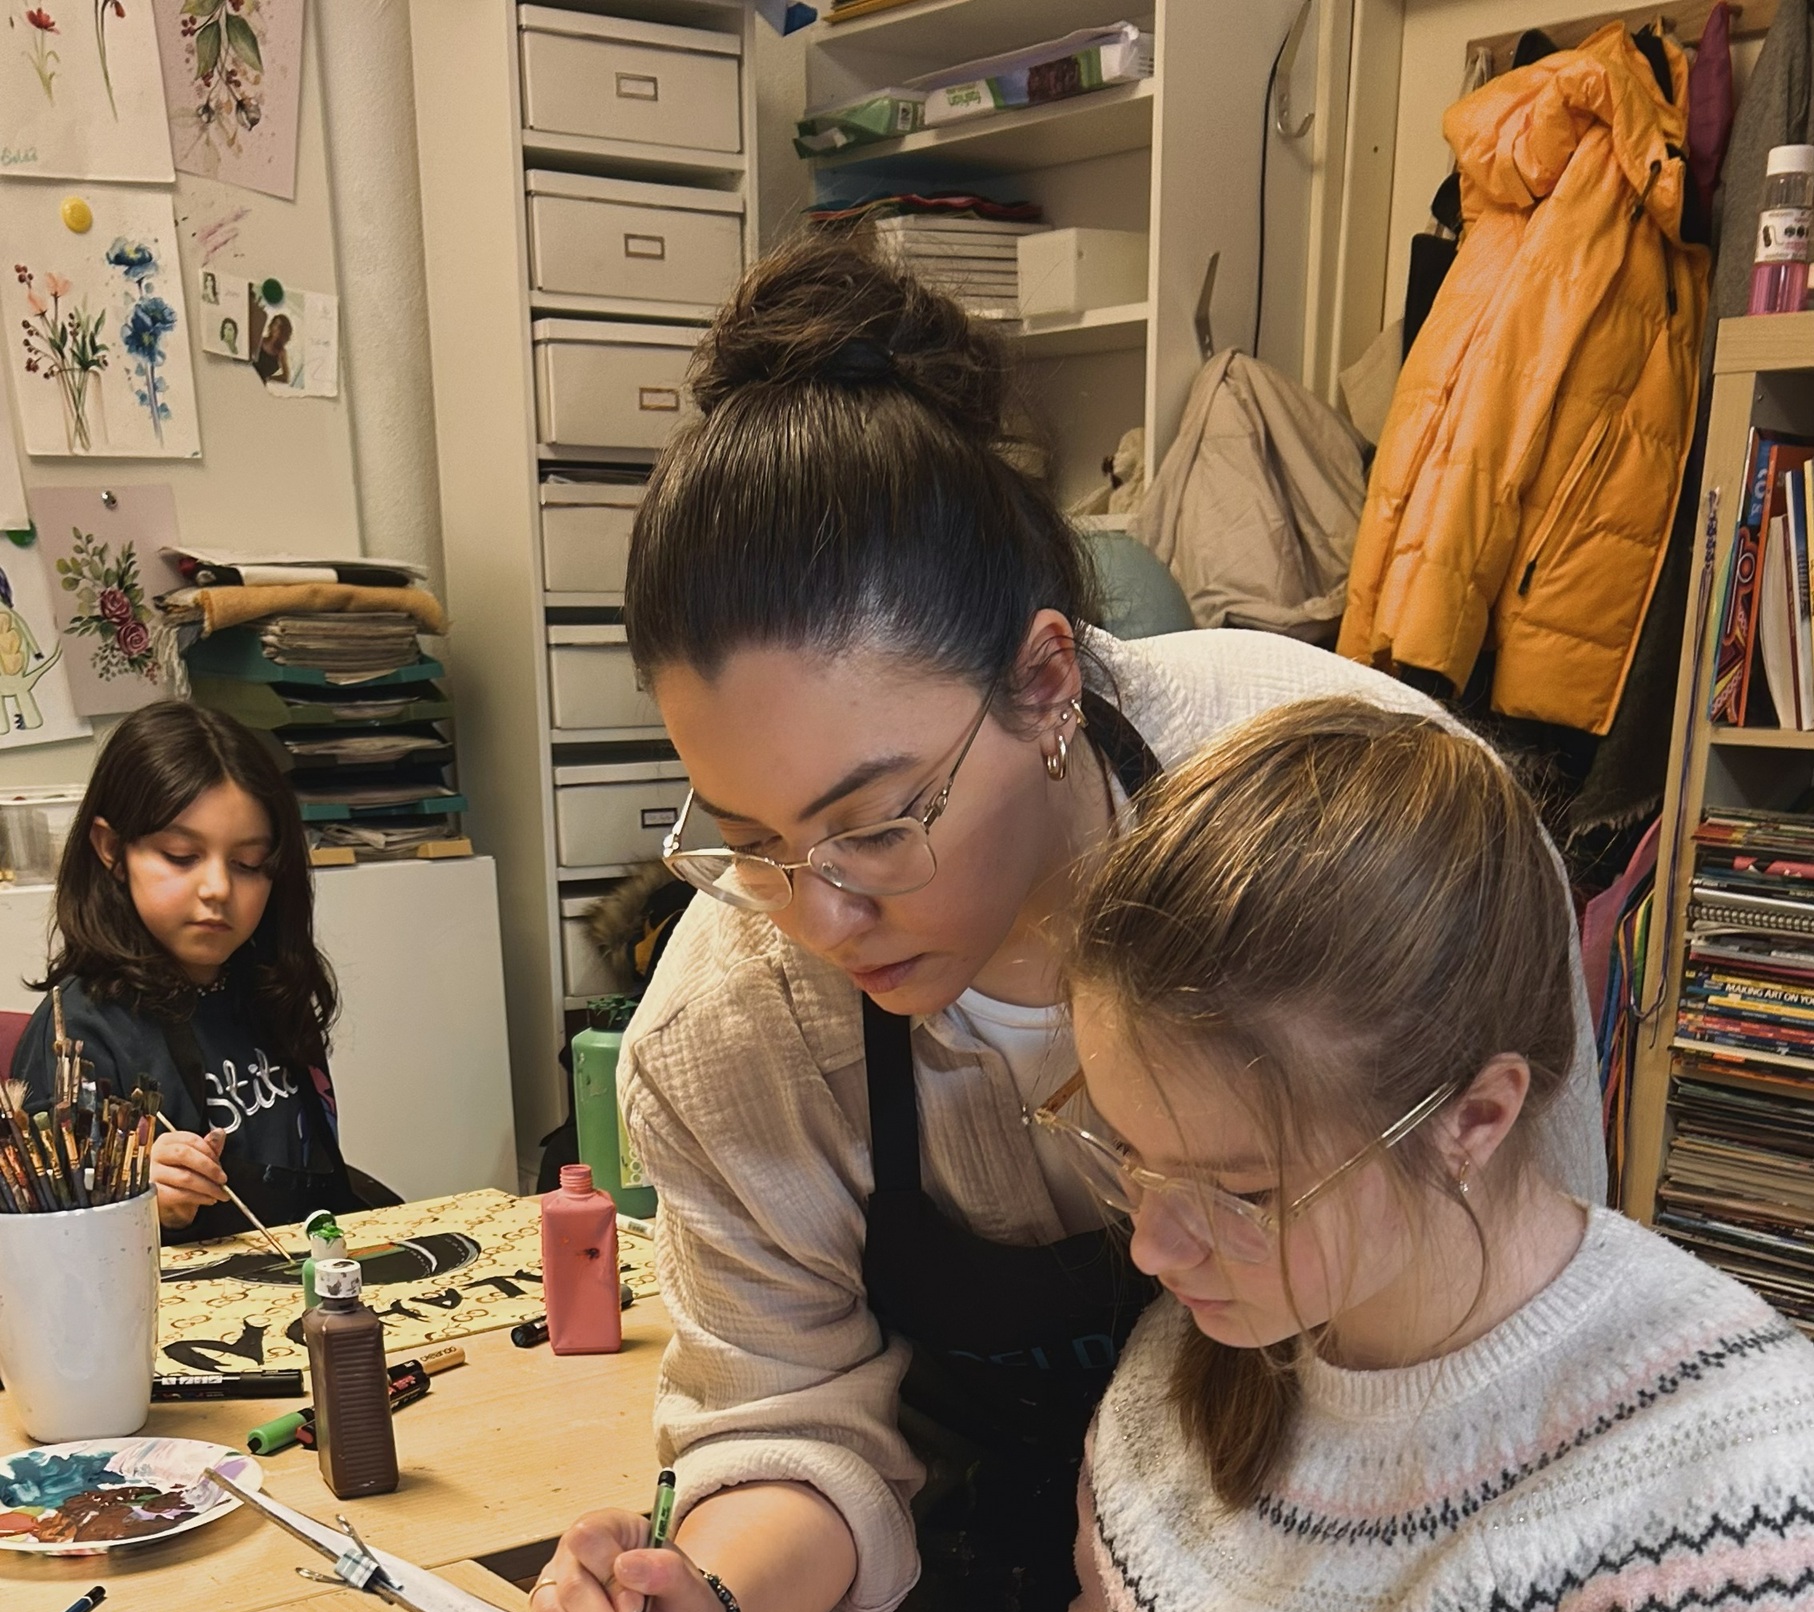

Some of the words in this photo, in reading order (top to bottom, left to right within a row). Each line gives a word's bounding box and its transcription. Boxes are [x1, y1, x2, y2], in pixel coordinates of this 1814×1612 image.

[1725, 983, 1763, 997] MAKING
[1764, 989, 1783, 999] ART
[1783, 992, 1799, 1003] ON
